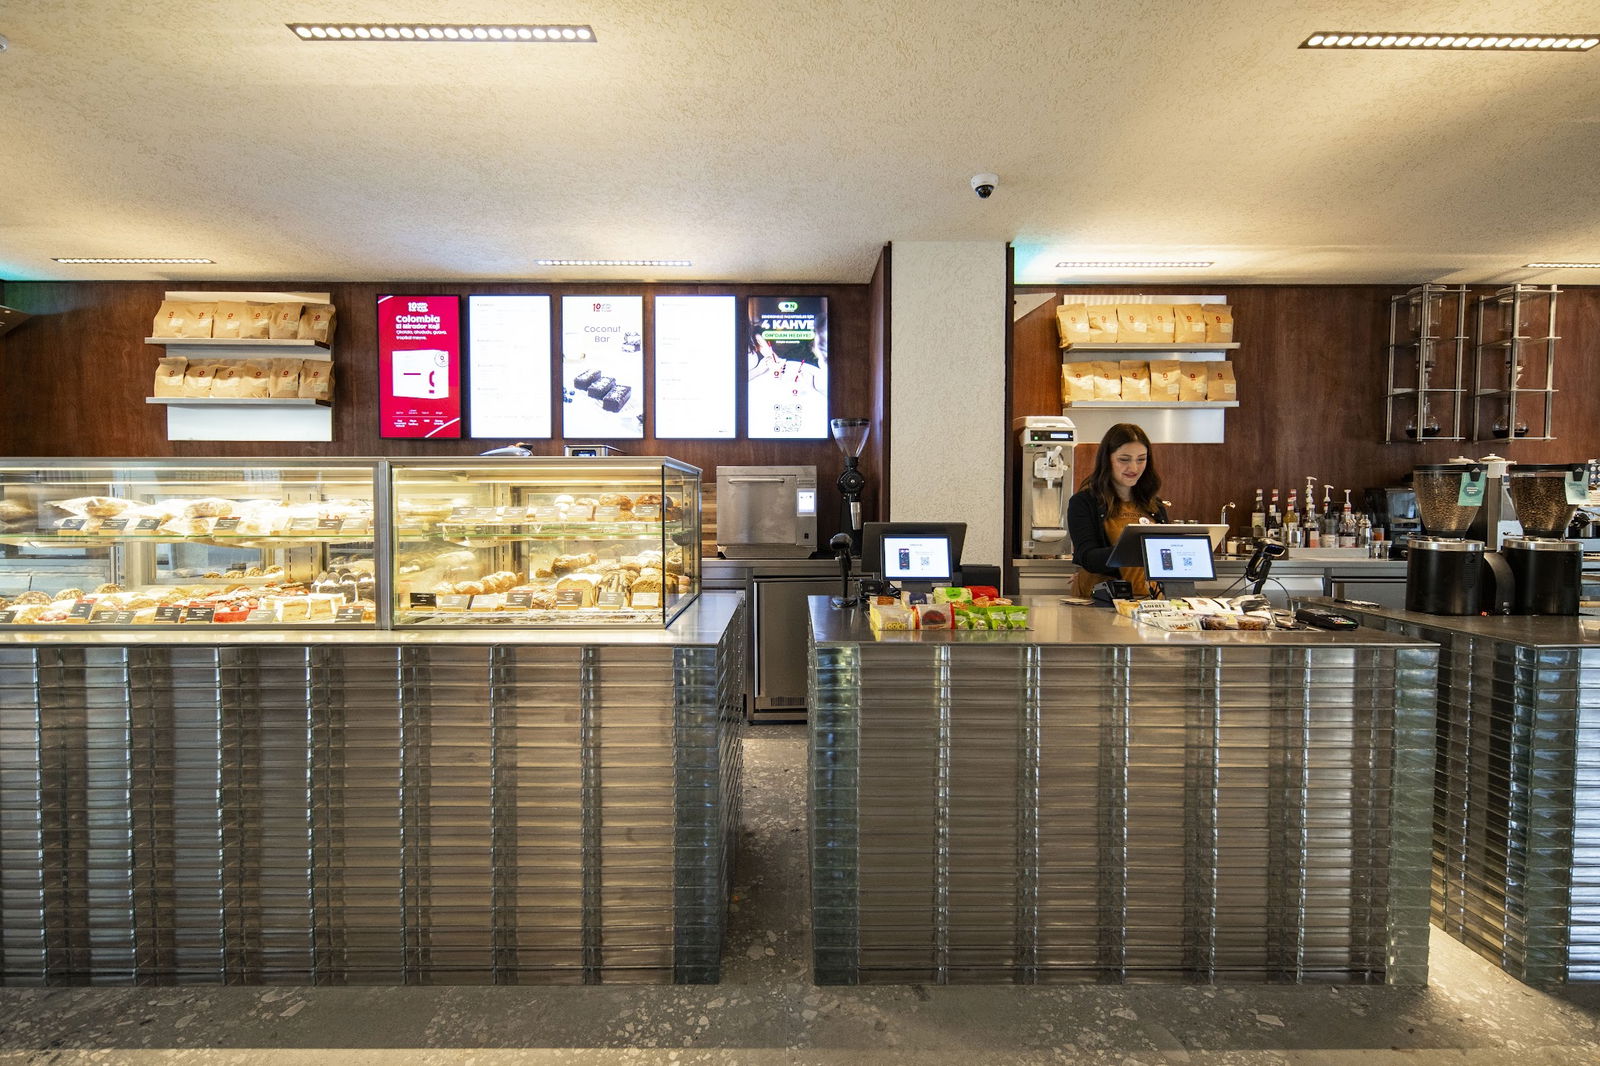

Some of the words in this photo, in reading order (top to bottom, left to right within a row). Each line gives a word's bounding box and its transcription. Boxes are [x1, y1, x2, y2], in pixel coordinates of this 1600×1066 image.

[396, 315, 440, 323] Colombia
[761, 320, 770, 329] 4
[773, 320, 814, 329] KAHVE
[584, 325, 621, 333] Coconut
[594, 335, 611, 343] Bar
